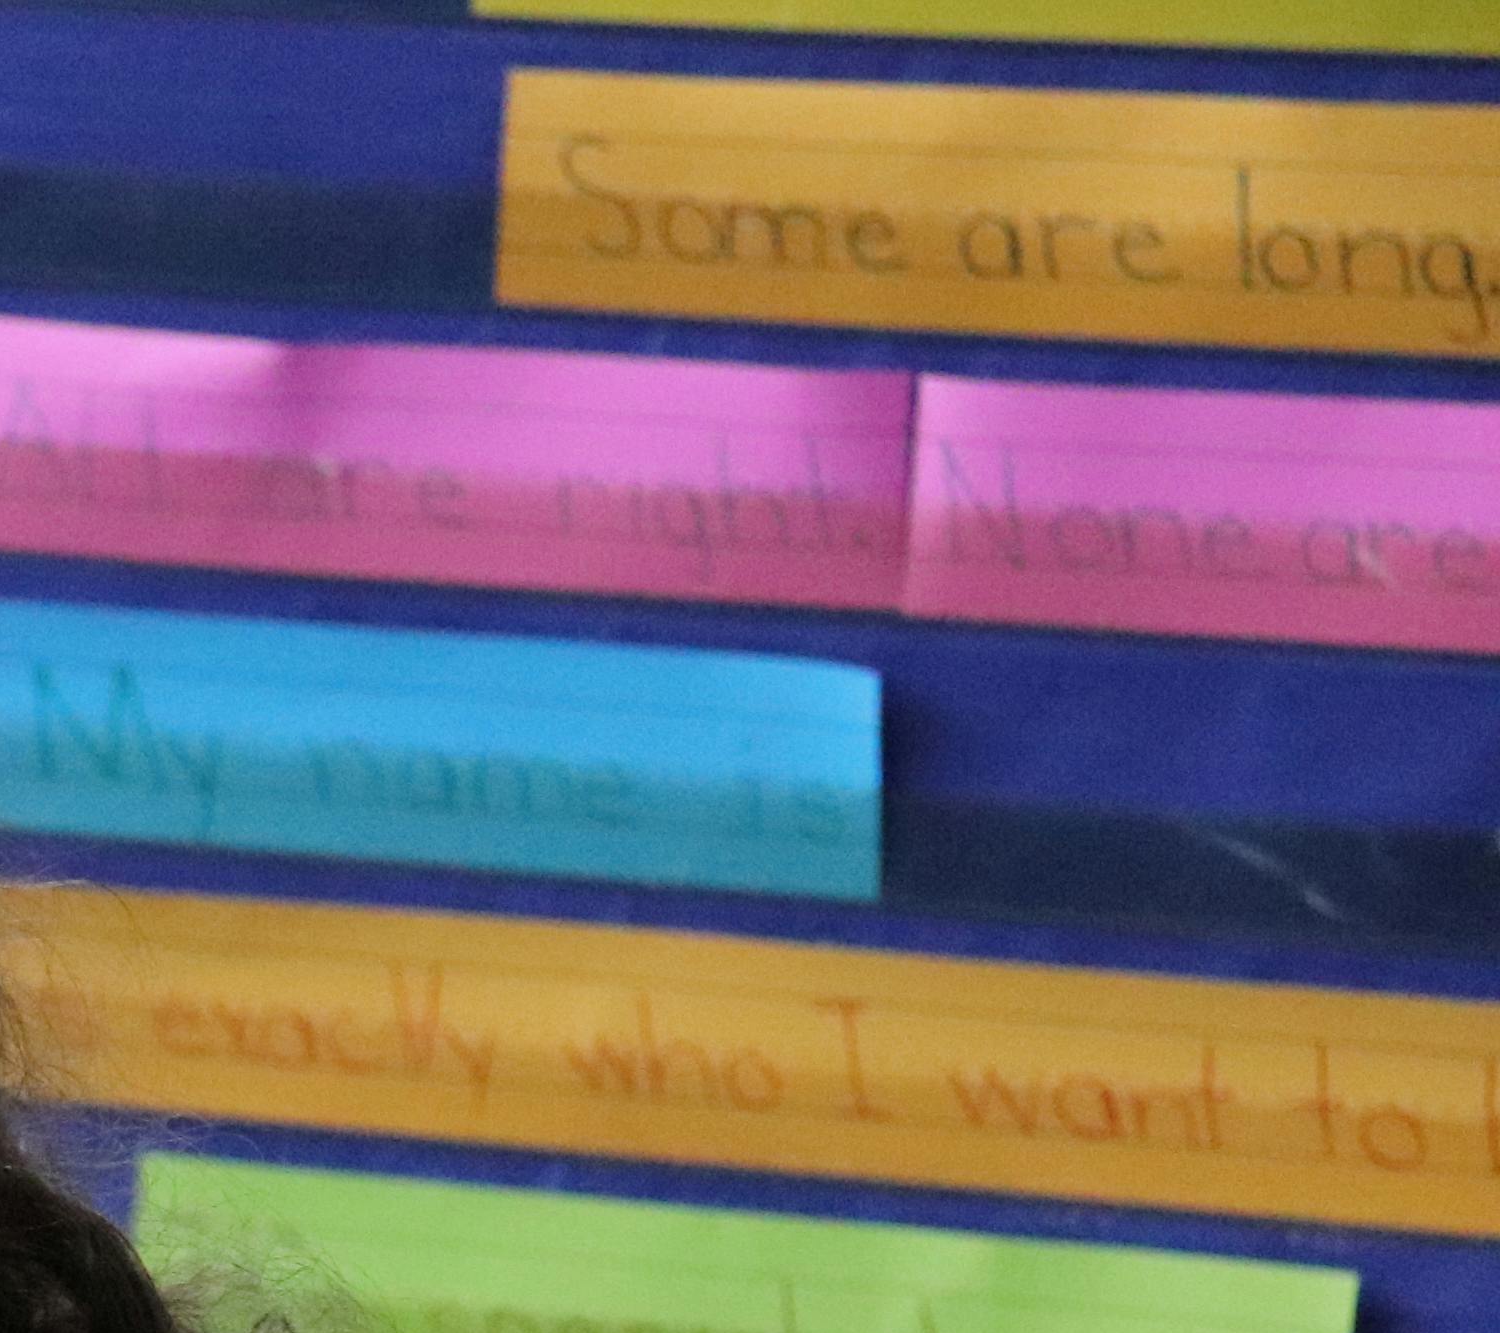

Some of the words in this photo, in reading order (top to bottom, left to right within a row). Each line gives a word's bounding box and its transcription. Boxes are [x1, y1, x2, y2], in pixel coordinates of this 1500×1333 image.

[558, 131, 911, 276] Some
[957, 211, 1181, 286] are
[249, 452, 471, 527] are
[937, 437, 1255, 574] None
[1301, 505, 1496, 594] are
[31, 660, 227, 838] My
[308, 738, 642, 829] name
[741, 740, 848, 845] is
[152, 957, 498, 1115] exactly
[563, 985, 785, 1112] who
[813, 995, 893, 1124] I
[947, 1043, 1234, 1152] want
[1302, 1042, 1428, 1174] to
